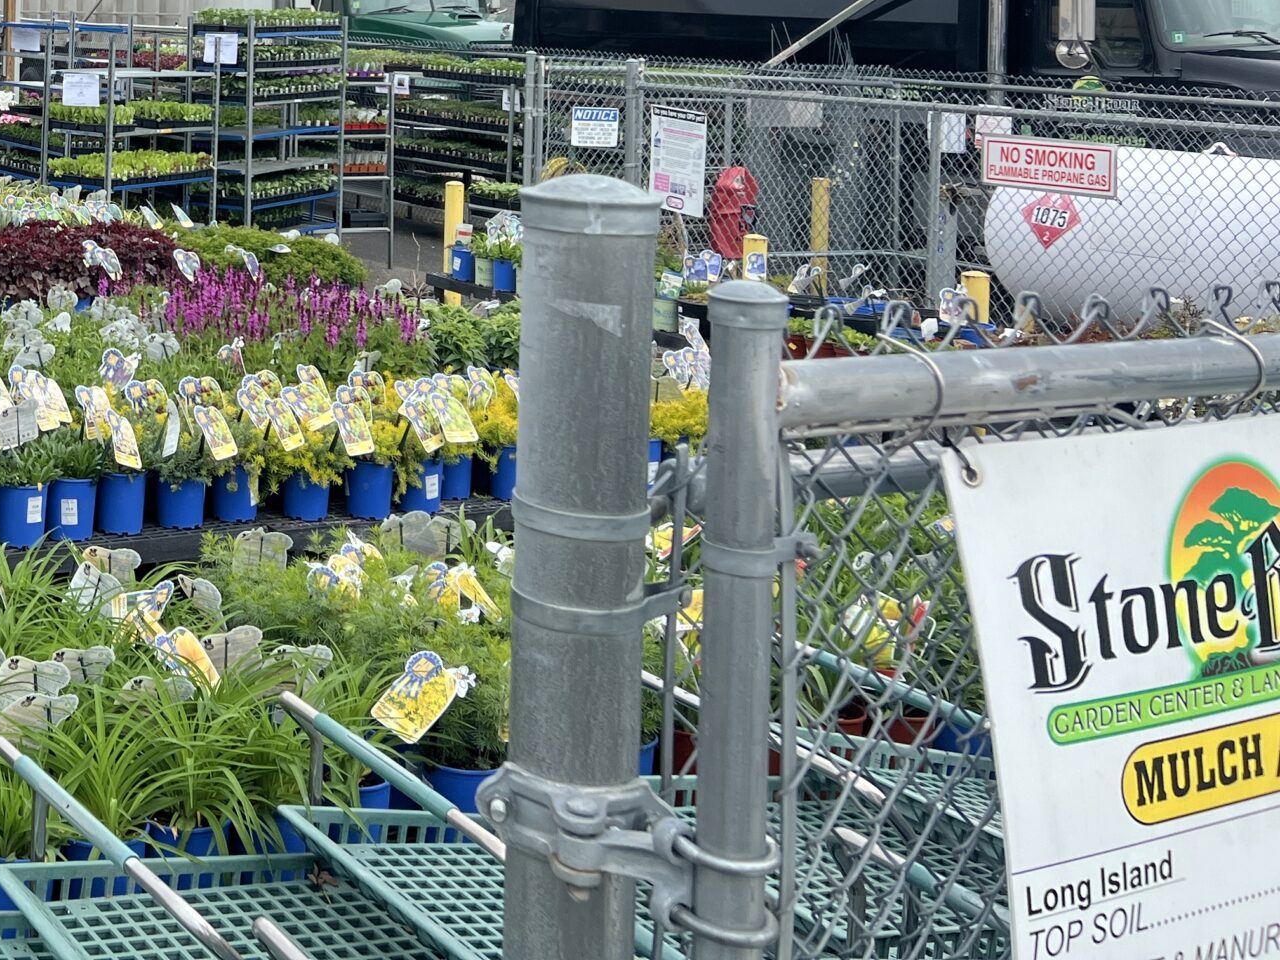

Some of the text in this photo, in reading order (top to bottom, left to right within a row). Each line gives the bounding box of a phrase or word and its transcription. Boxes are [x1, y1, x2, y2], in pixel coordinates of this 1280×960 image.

[574, 109, 618, 121] NOTICE
[1000, 146, 1096, 171] NO SMOKING
[989, 164, 1107, 187] FLAMMABLE PROPANE GAS
[1034, 206, 1068, 228] 1075
[1042, 231, 1050, 242] 2
[1006, 553, 1239, 694] Stone
[1054, 697, 1144, 736] GARDEN
[1149, 681, 1228, 717] CENTER
[1232, 677, 1245, 698] &
[1134, 733, 1264, 807] MULCH
[1026, 850, 1173, 911] Long Island
[1029, 919, 1084, 960] TOP
